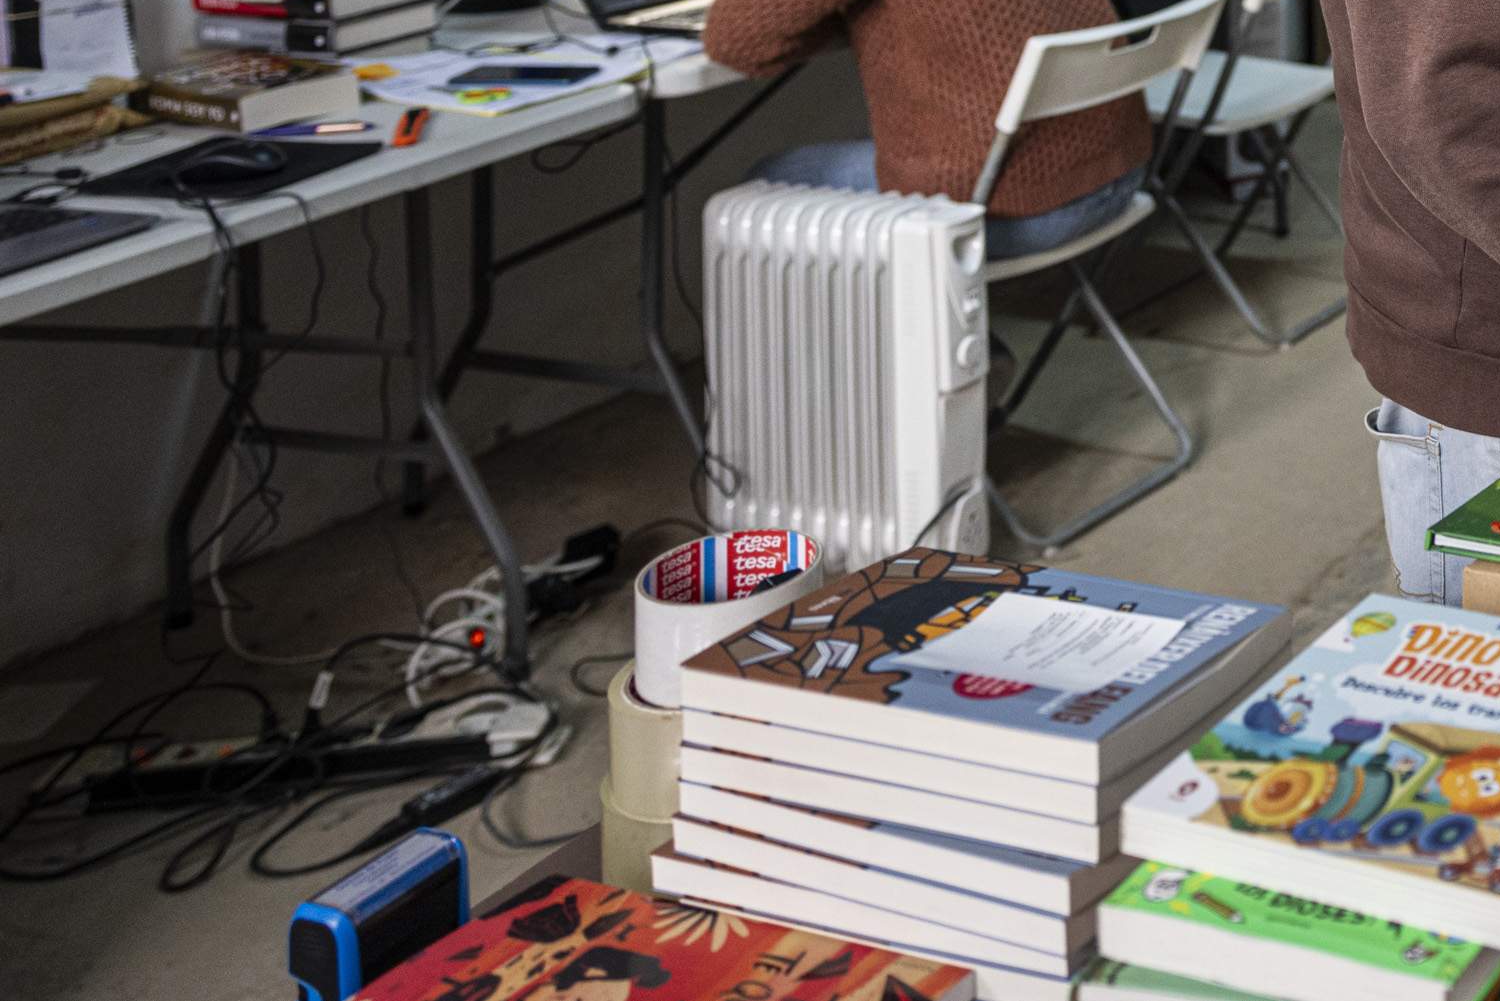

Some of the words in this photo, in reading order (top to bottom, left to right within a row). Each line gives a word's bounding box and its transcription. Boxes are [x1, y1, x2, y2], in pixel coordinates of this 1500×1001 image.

[662, 552, 691, 573] tesa
[734, 554, 777, 570] tesa
[662, 564, 691, 585] tesa
